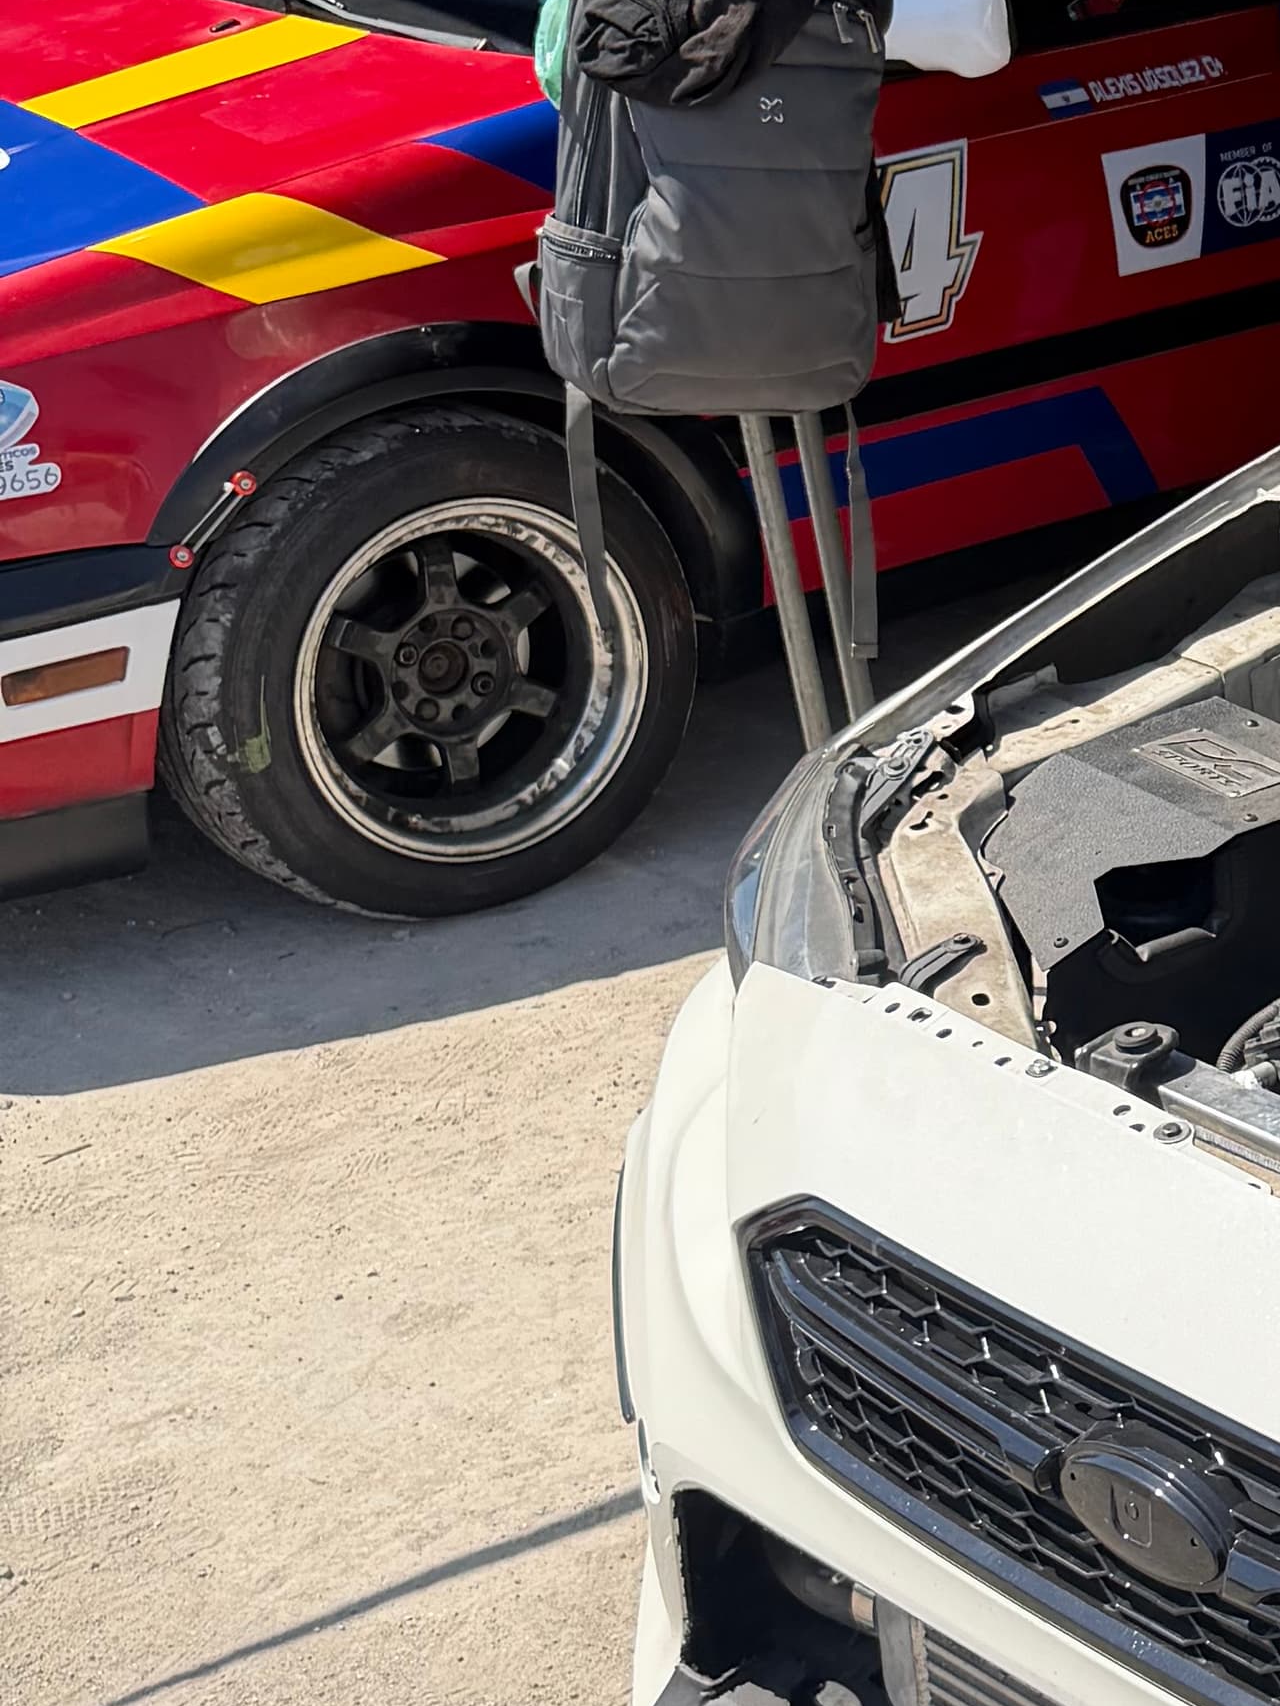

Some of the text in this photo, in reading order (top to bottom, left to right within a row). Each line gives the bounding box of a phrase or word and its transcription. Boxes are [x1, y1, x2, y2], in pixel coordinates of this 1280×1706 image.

[1220, 142, 1273, 162] MEMBER OF
[1145, 224, 1178, 243] ACES
